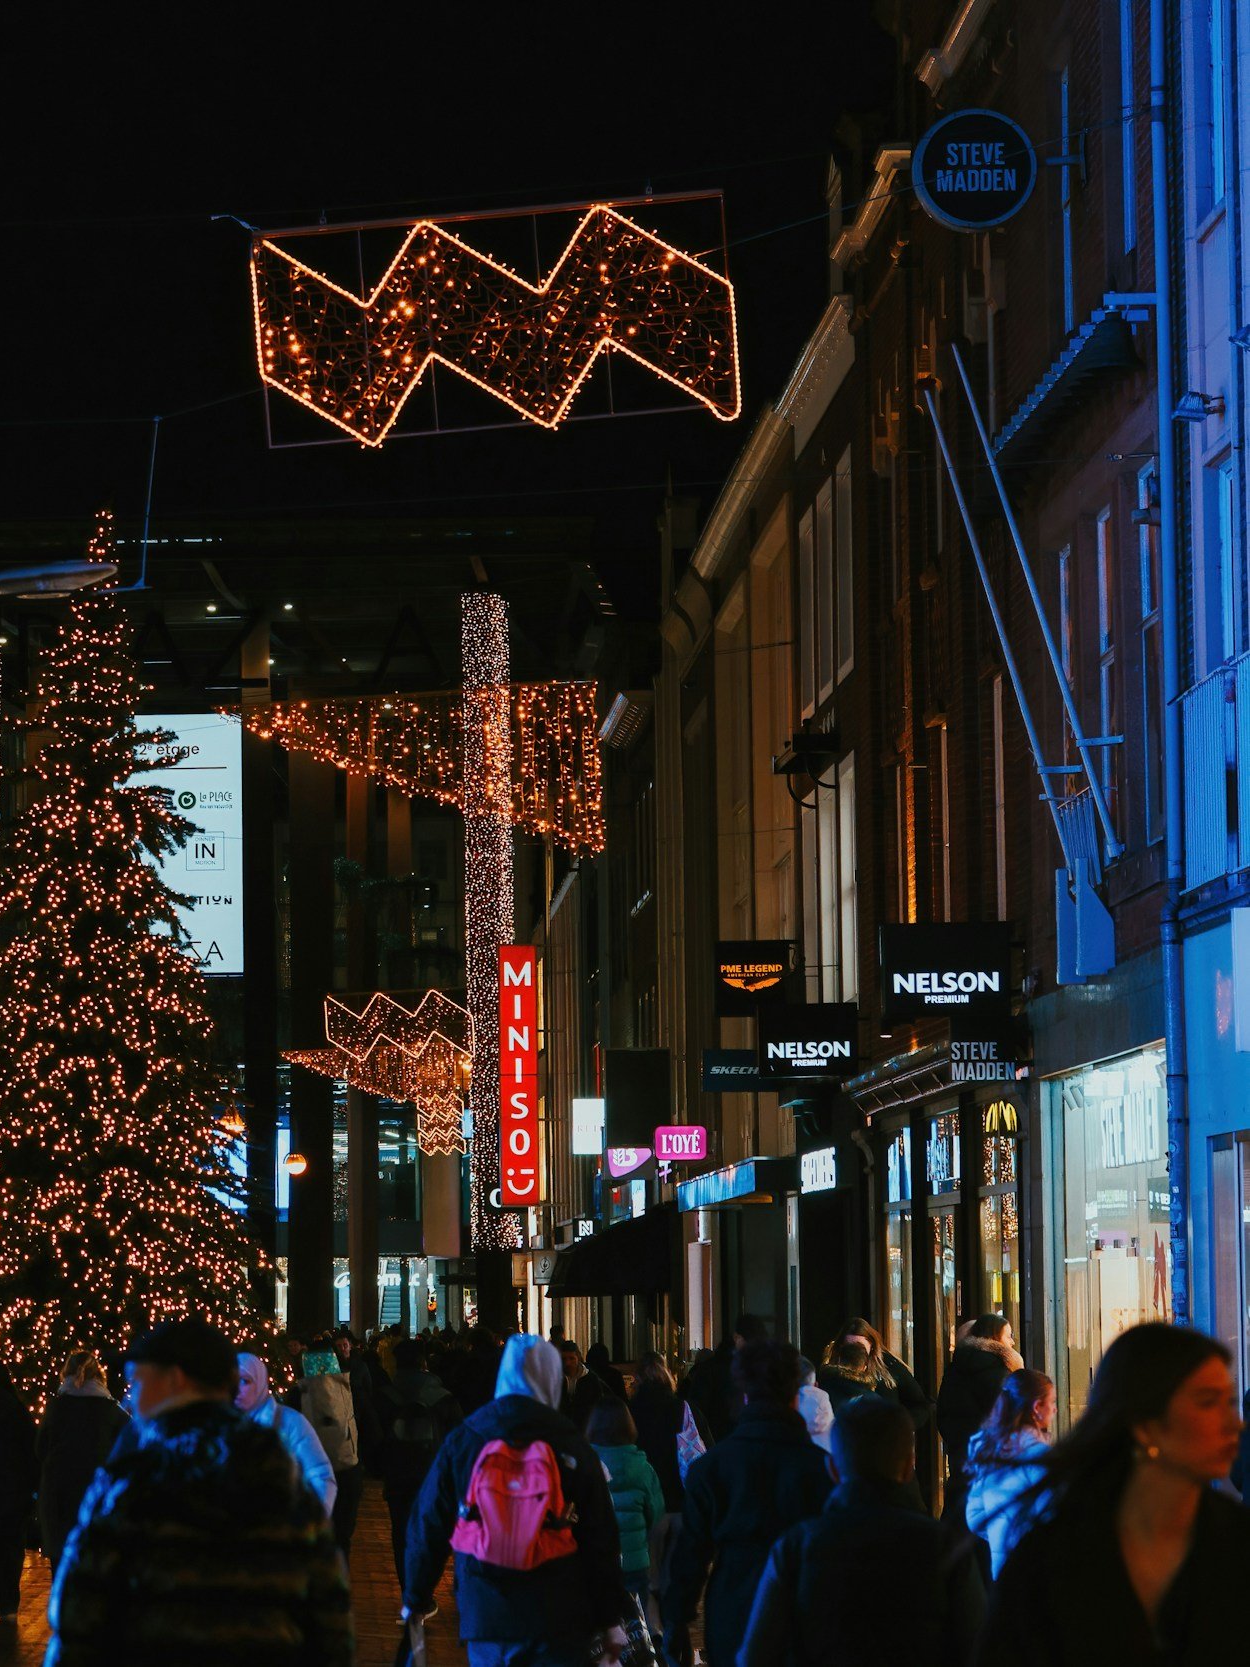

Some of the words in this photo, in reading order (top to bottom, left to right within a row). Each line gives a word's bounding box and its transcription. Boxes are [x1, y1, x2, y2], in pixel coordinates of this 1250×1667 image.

[947, 143, 1005, 166] STEVE
[937, 169, 1016, 192] MADDEN
[156, 744, 200, 759] etage
[209, 791, 232, 802] PLACE
[195, 843, 216, 859] IN
[720, 964, 742, 973] PME
[744, 964, 783, 973] LEGEND
[893, 971, 1000, 994] NELSON
[924, 994, 970, 1004] PREMIUM
[502, 960, 533, 1157] MINISO
[767, 1040, 851, 1059] NELSON
[951, 1041, 998, 1061] STEVE
[710, 1065, 760, 1075] SKECH
[791, 1058, 828, 1067] PREMIUM
[951, 1062, 1015, 1081] MADDEN
[661, 1130, 701, 1154] L'OYÉ
